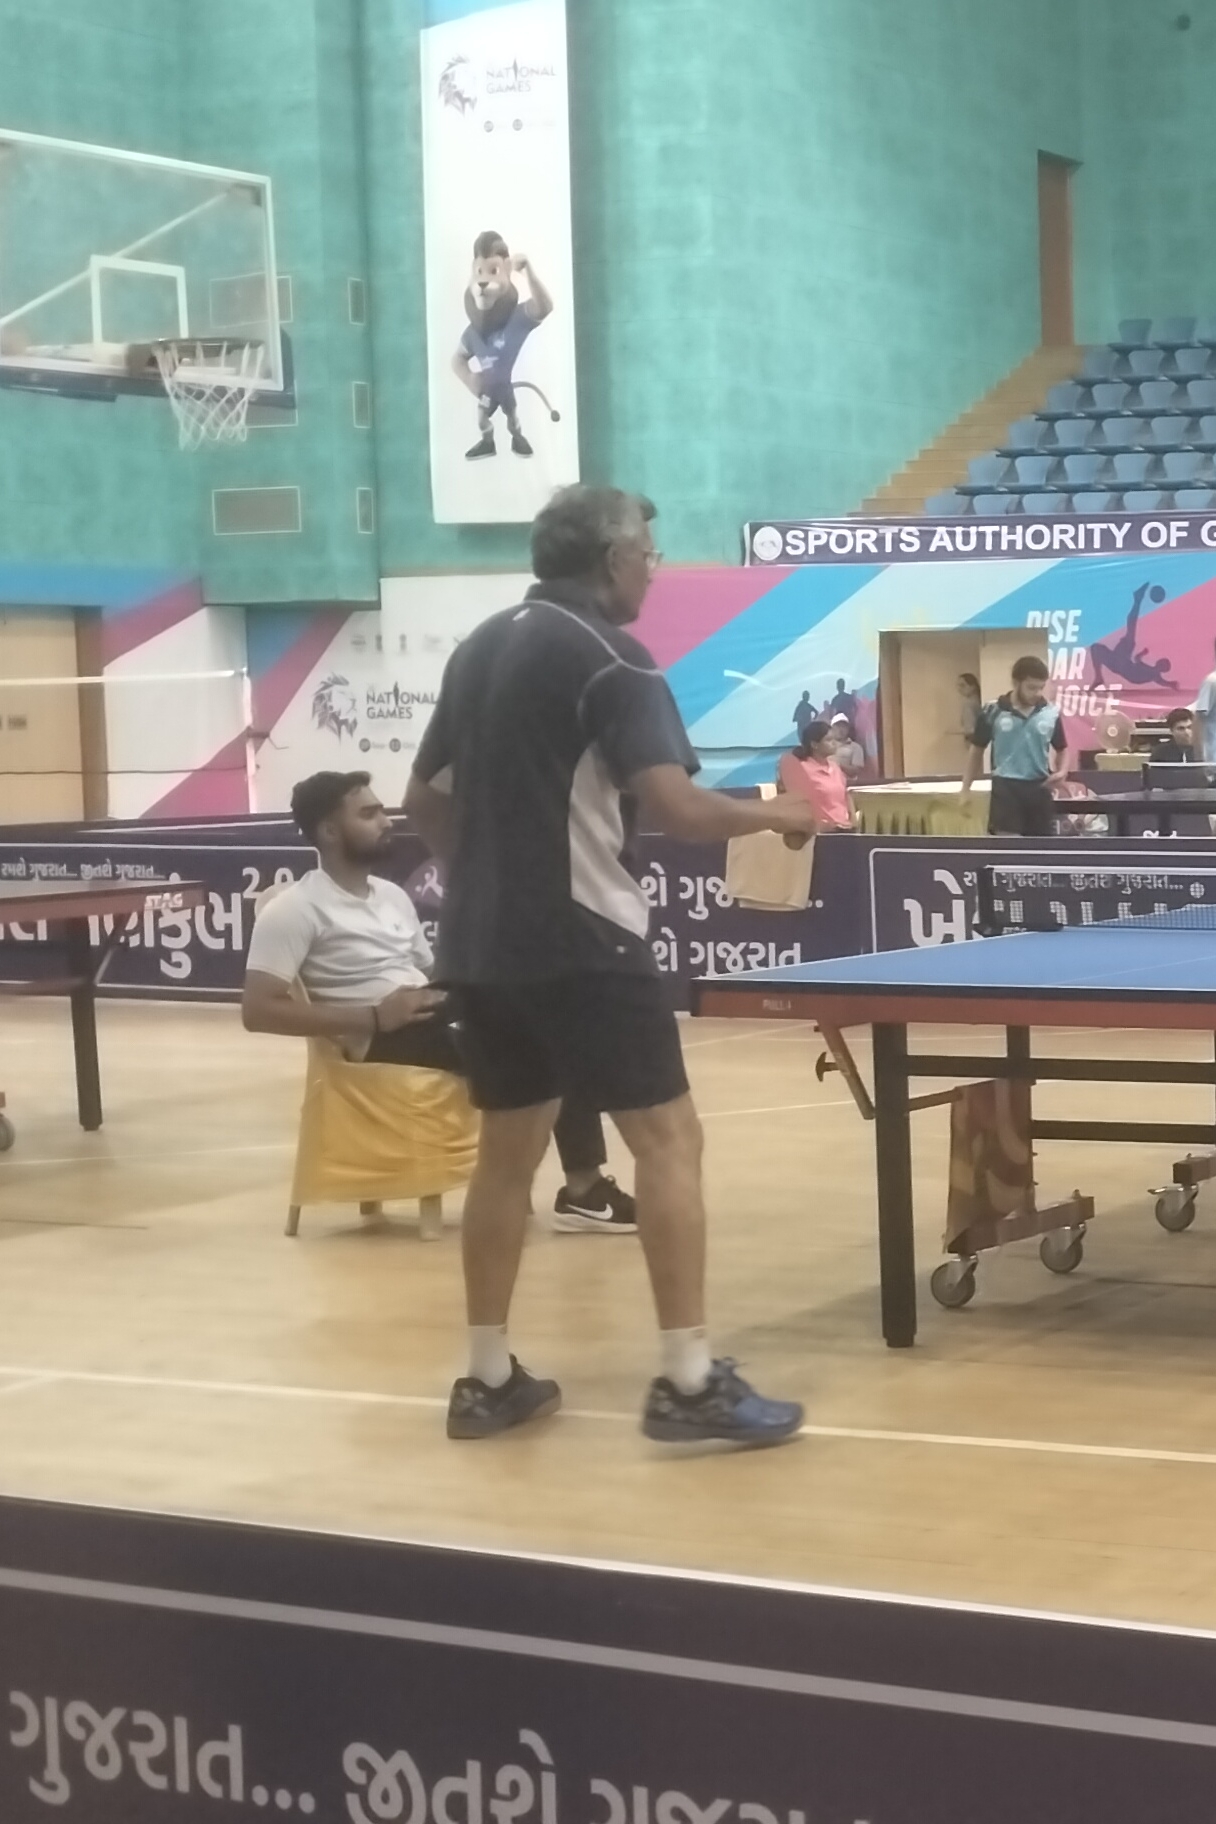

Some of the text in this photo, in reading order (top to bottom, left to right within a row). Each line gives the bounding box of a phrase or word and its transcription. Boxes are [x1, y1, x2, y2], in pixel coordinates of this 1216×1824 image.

[486, 58, 557, 80] NATIONAL
[486, 80, 532, 94] GAMES
[785, 526, 921, 555] SPORTS
[929, 522, 1131, 552] AUTHORITY
[1141, 521, 1189, 548] OF
[366, 681, 438, 706] NATIONAL
[366, 706, 414, 720] GAMES
